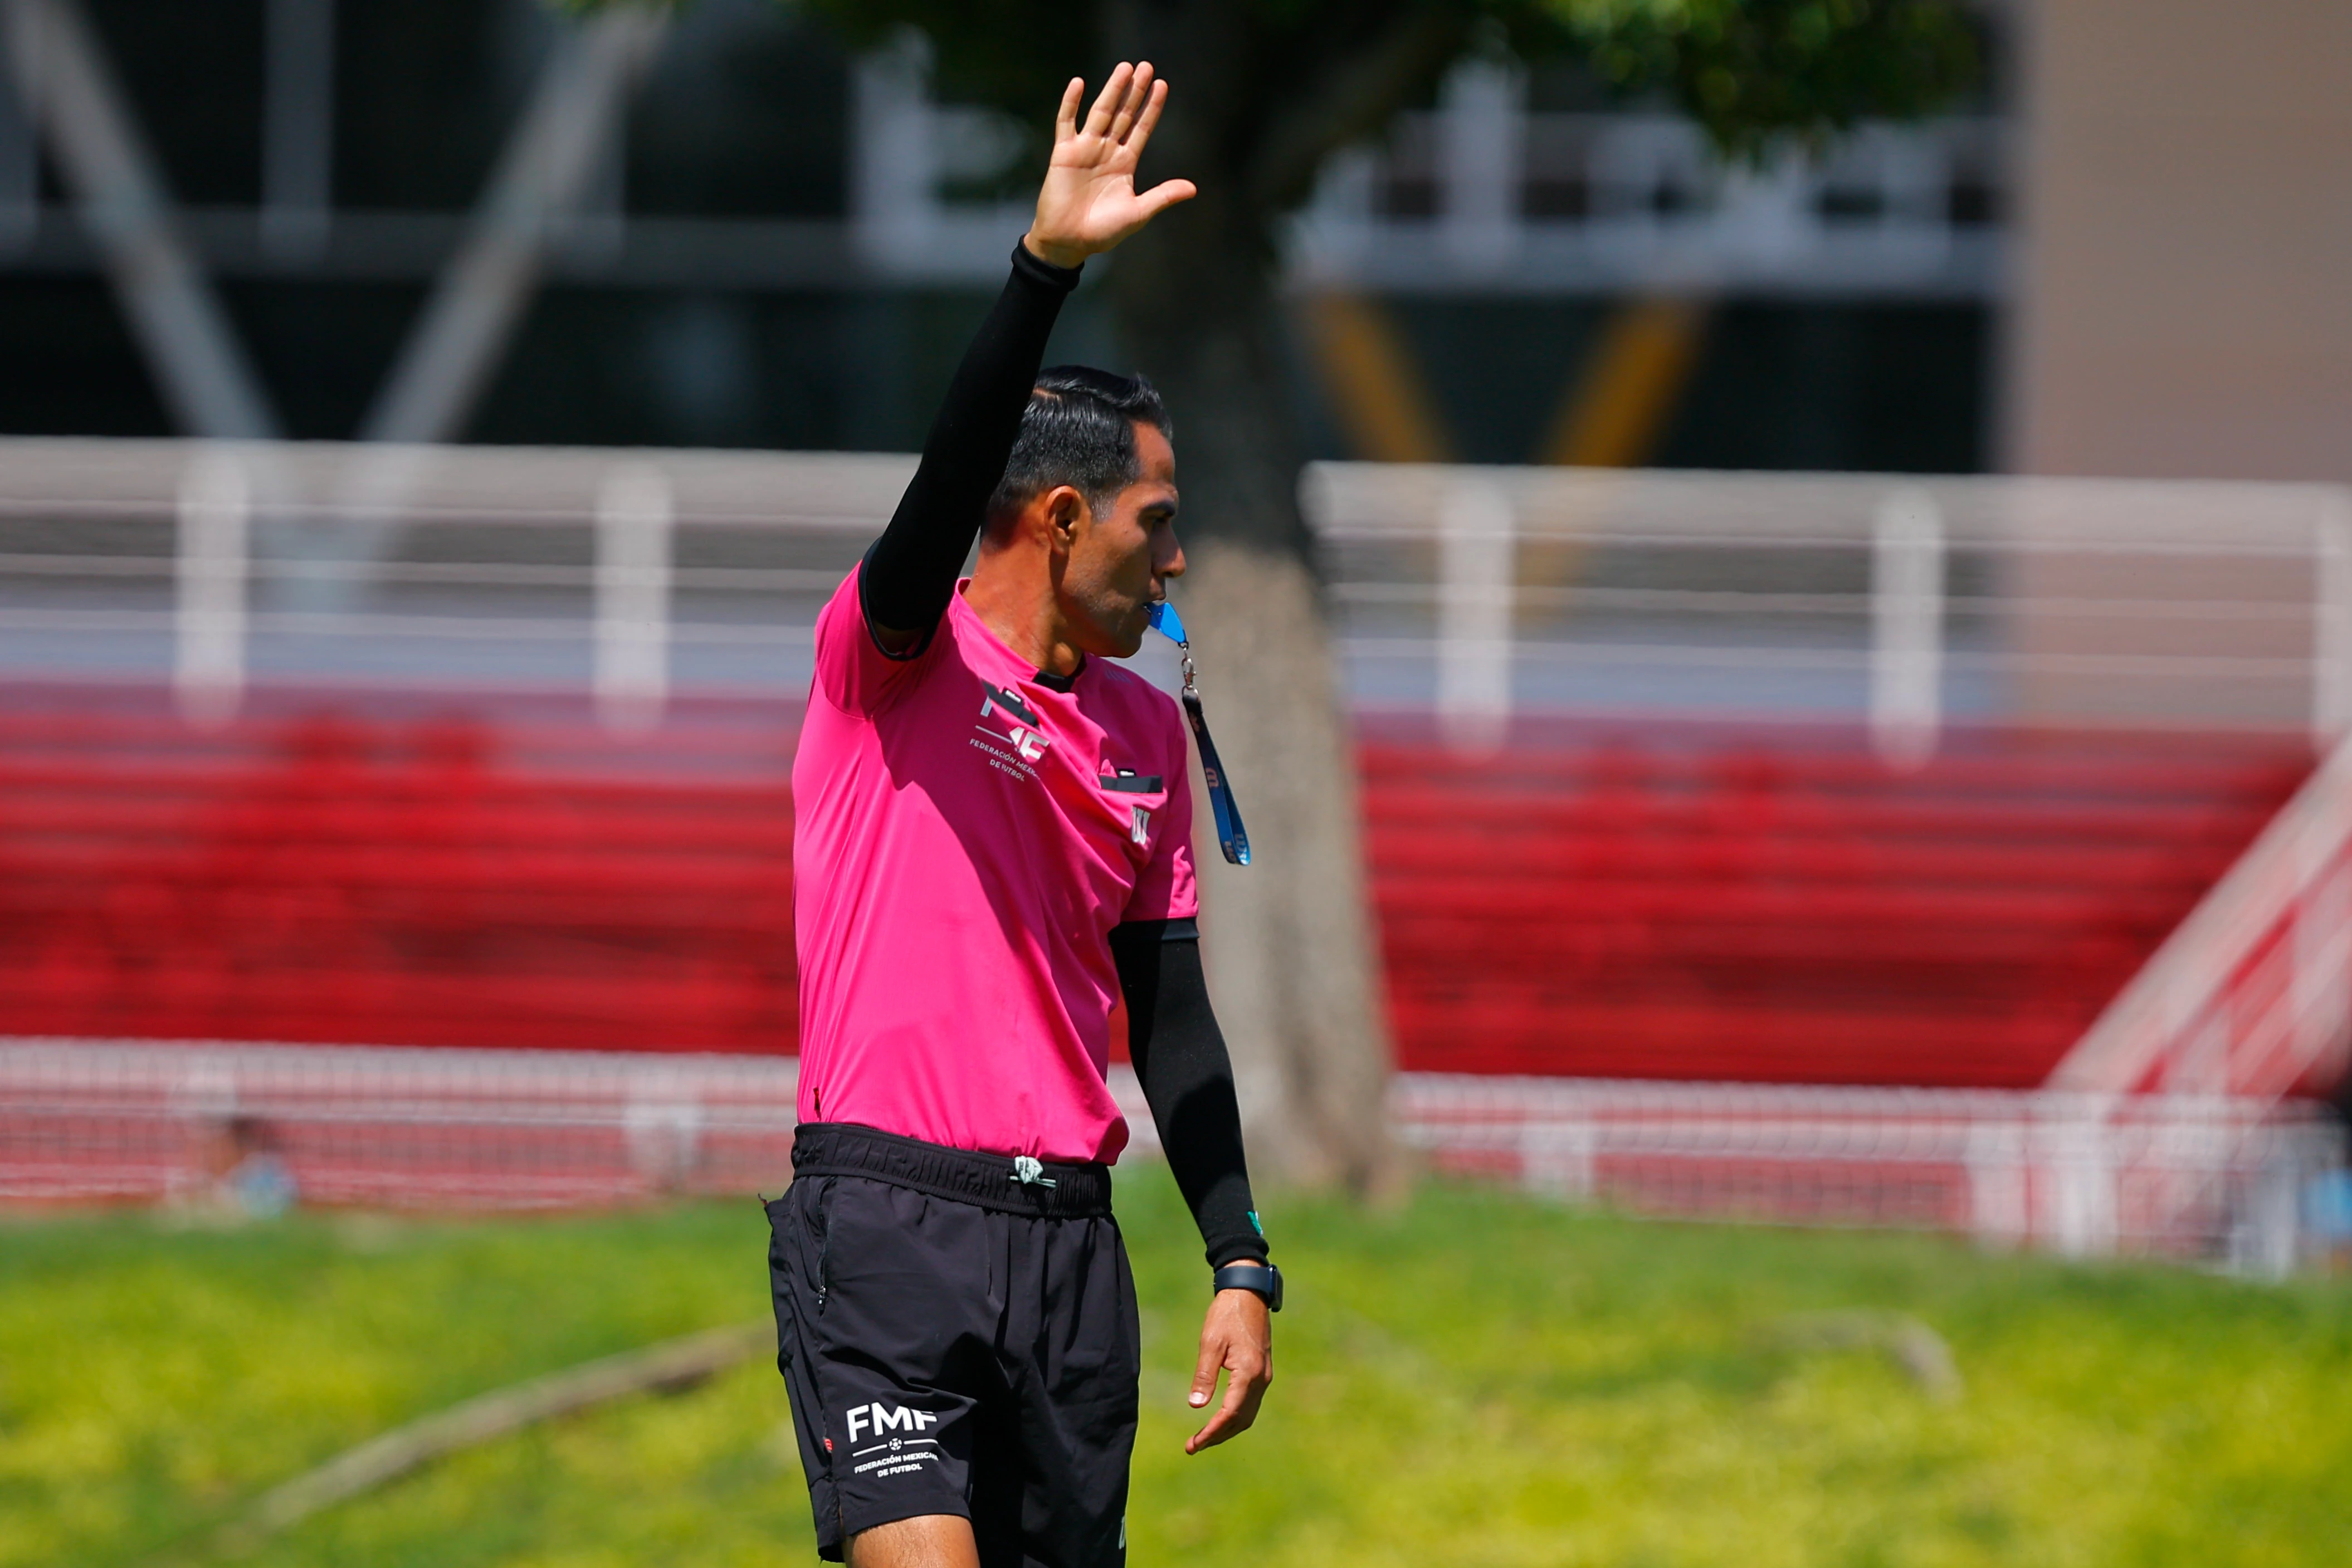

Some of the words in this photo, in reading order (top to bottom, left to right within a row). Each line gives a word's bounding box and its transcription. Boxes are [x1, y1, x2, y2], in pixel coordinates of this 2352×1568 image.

[969, 738, 1016, 764] FEDERACIÓN
[989, 759, 1001, 768] DE
[846, 1401, 938, 1443] FMF
[854, 1454, 902, 1474] FEDERACIÓN
[877, 1468, 889, 1478] DE
[890, 1463, 923, 1475] FUTBOL
